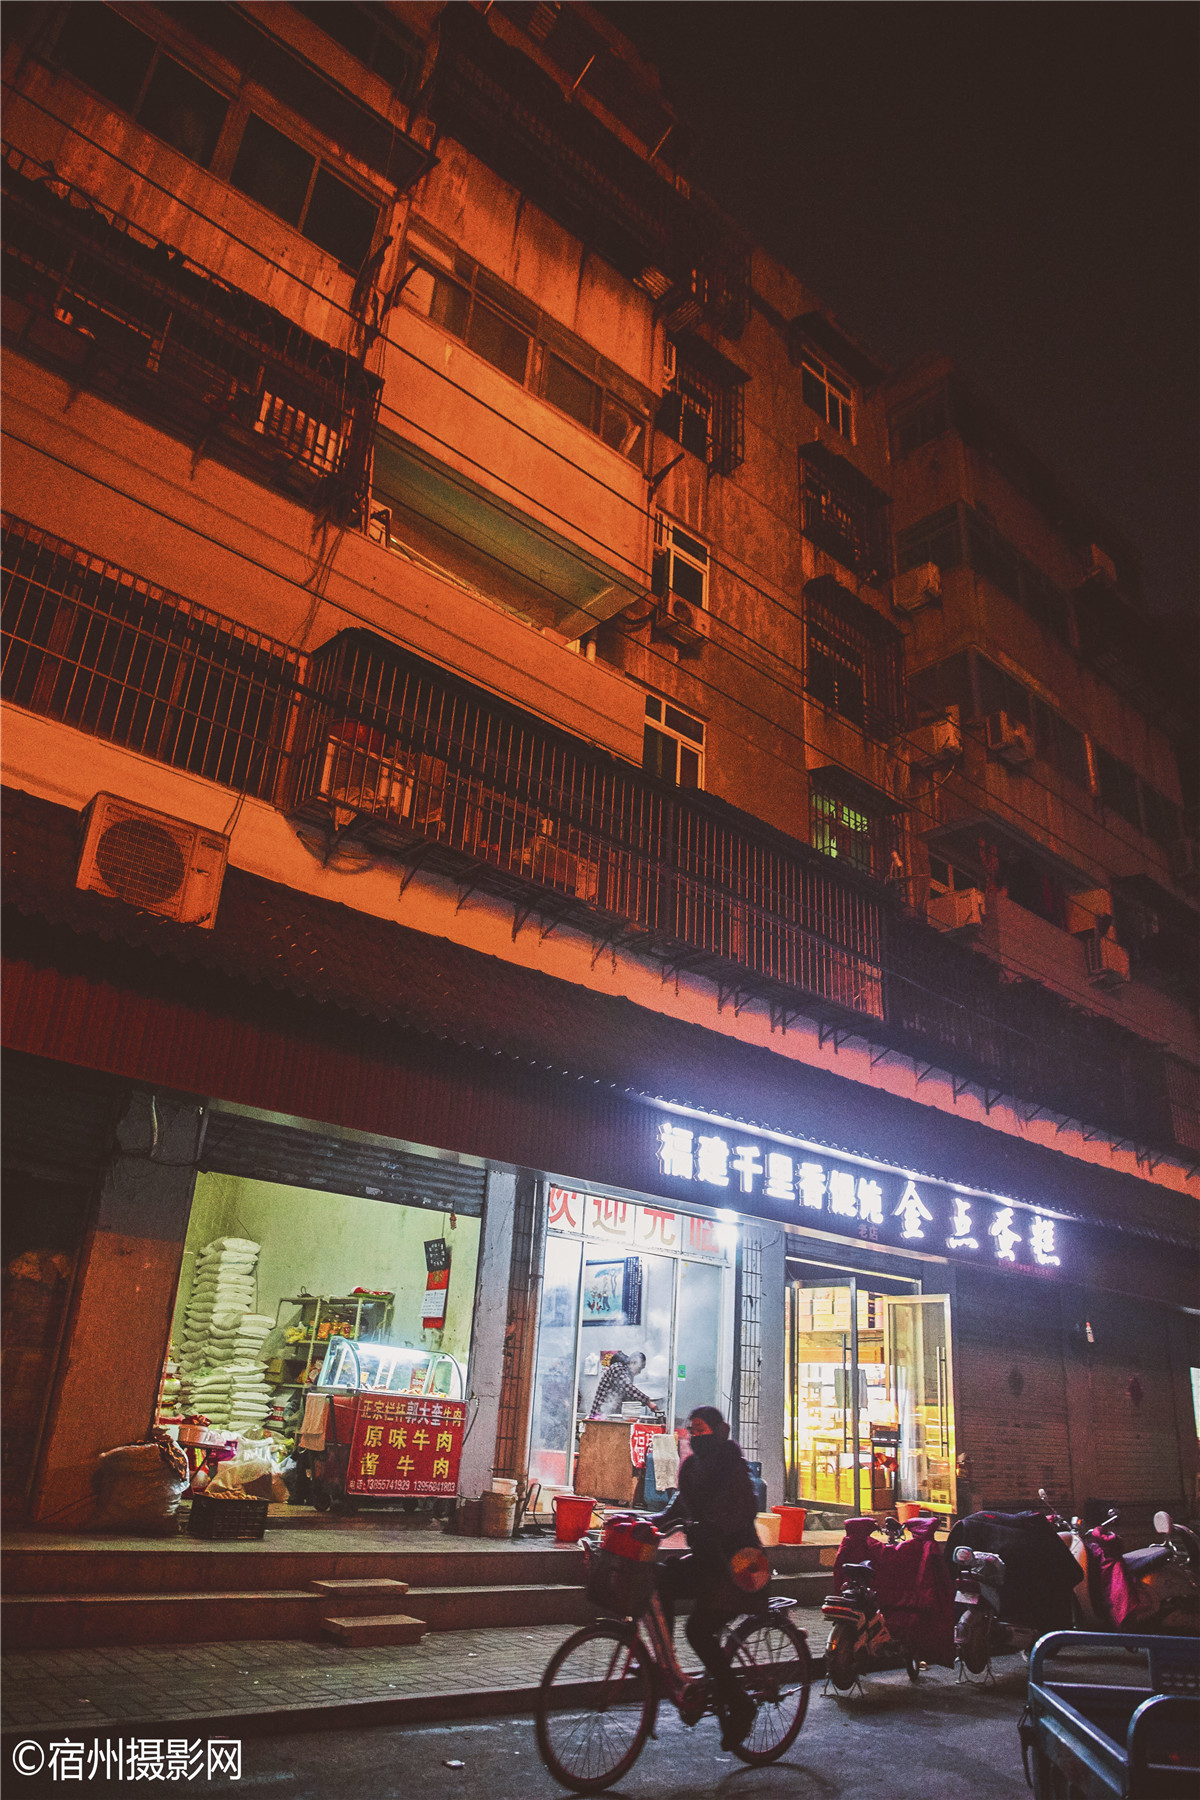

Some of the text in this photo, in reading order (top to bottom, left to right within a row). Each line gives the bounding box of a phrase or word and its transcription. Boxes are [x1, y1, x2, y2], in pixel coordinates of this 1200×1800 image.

[656, 1122, 884, 1224] 福建千里香馄饨
[892, 1180, 1061, 1266] 金点蛋糕
[360, 1452, 450, 1479] 酱牛肉
[363, 1425, 453, 1453] 原味牛肉
